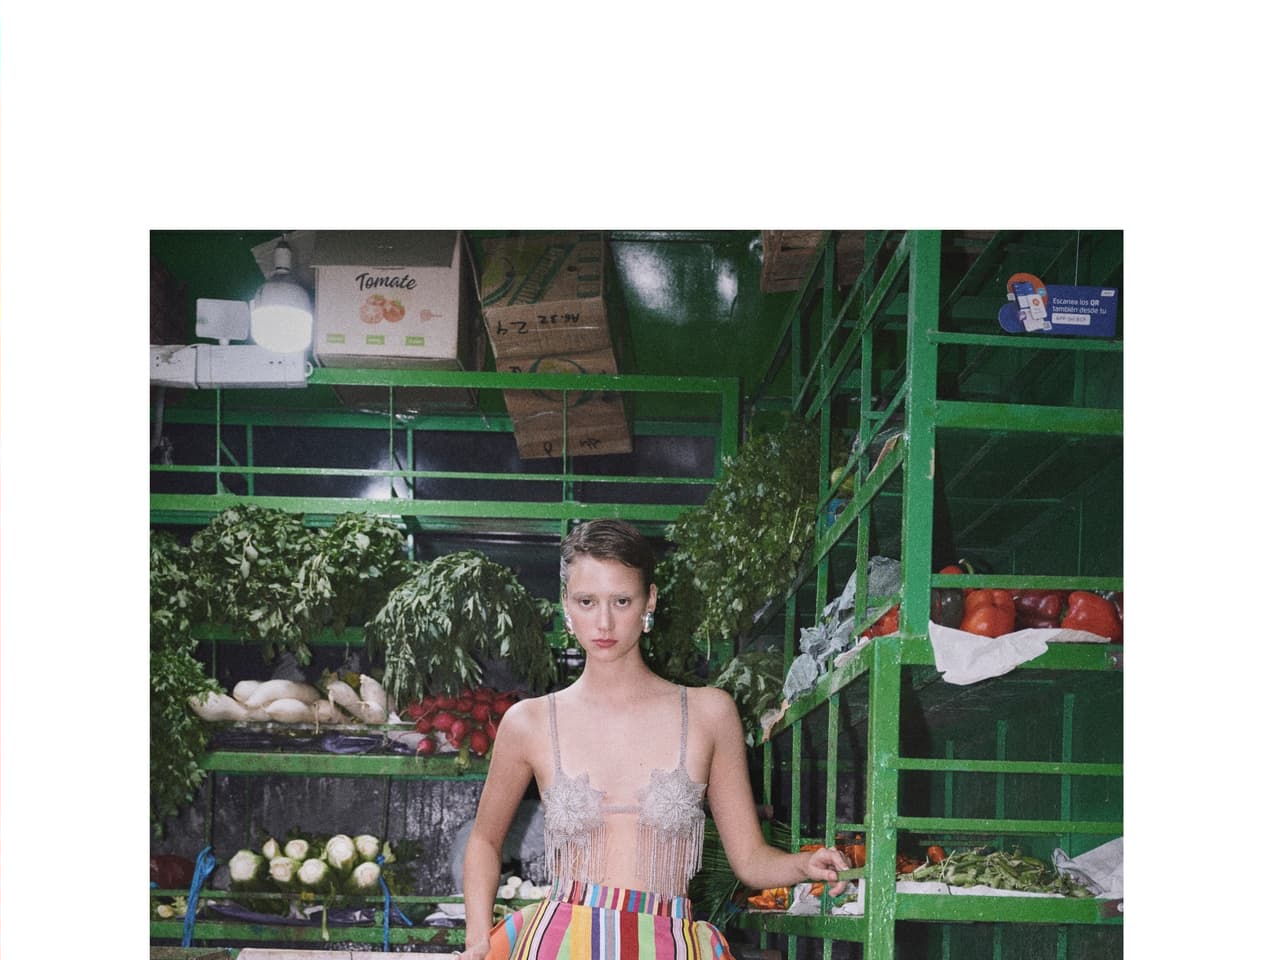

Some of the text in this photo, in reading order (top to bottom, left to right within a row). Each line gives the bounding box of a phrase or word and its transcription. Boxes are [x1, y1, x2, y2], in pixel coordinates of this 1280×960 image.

[355, 272, 417, 291] Tomate
[1052, 297, 1078, 305] Escanea
[1080, 298, 1089, 306] los
